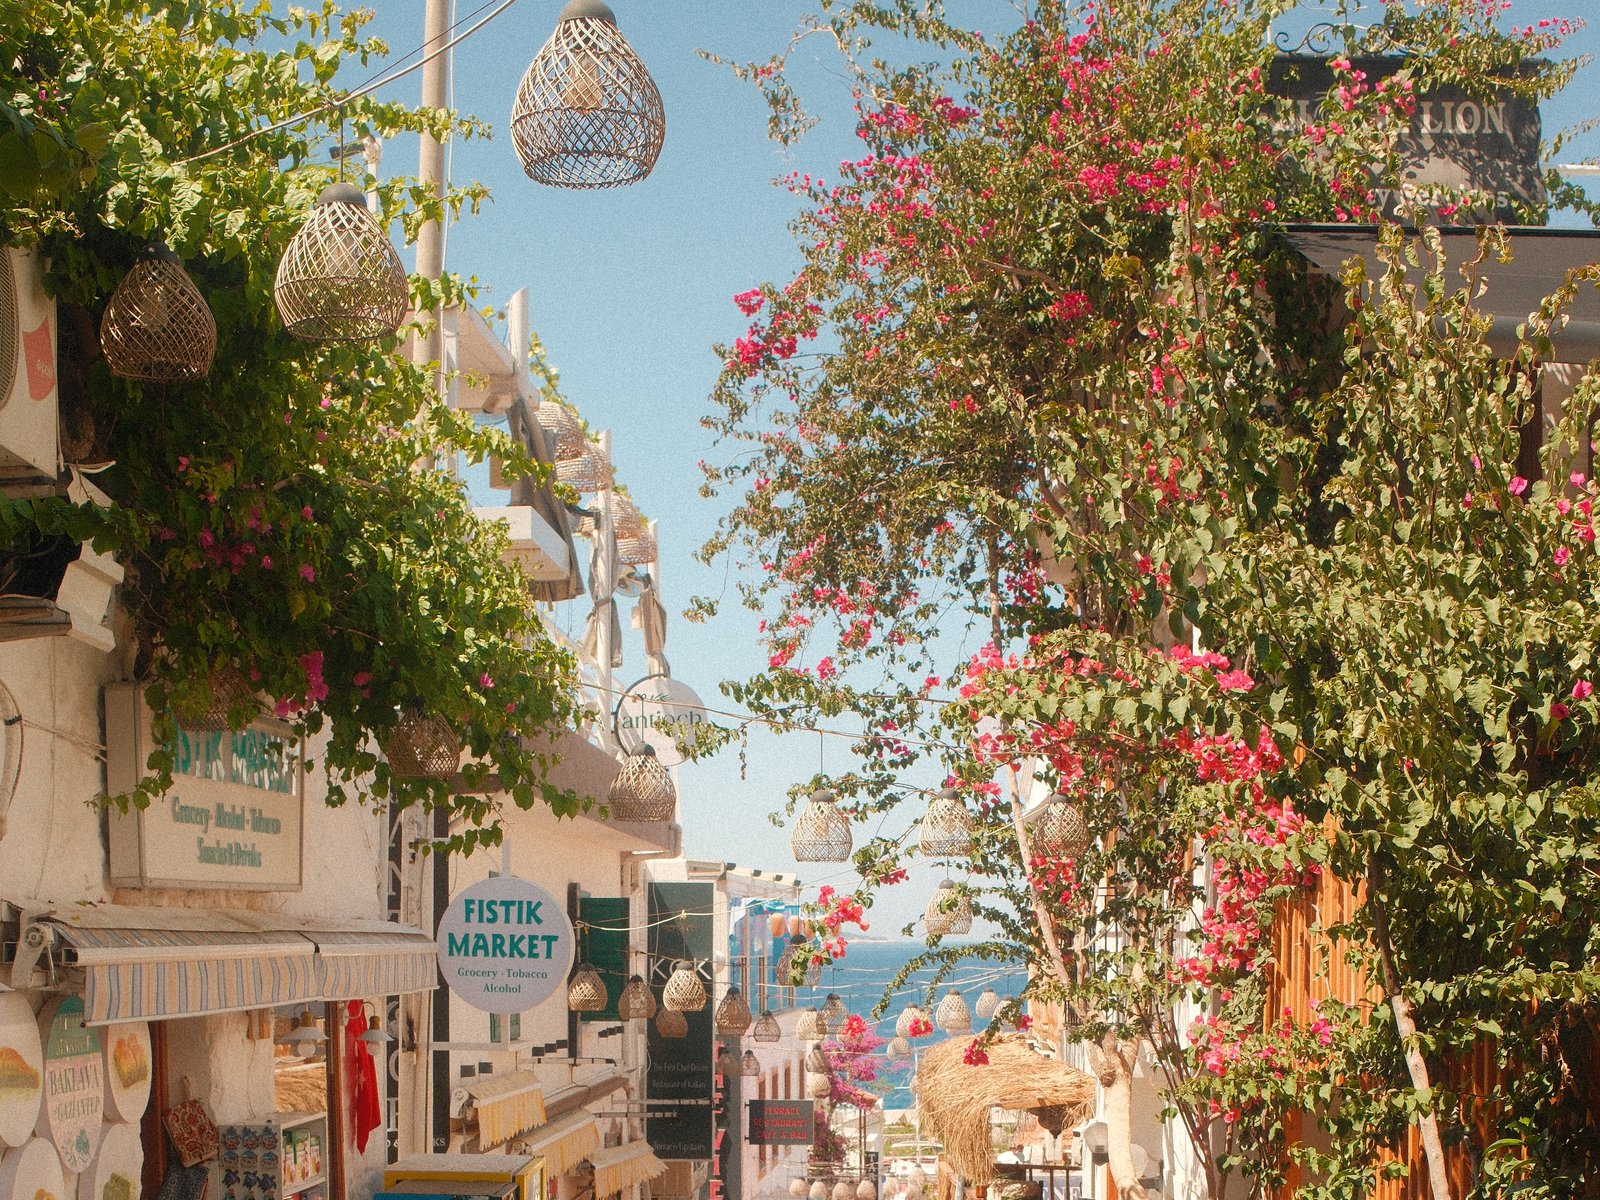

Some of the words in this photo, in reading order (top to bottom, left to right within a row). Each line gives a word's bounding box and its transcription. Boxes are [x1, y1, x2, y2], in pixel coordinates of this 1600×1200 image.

[1420, 101, 1505, 134] LION
[171, 796, 210, 834] Grocery
[464, 899, 543, 925] FISTIK
[447, 932, 559, 959] MARKET
[457, 967, 498, 980] Grocery
[506, 968, 548, 979] Tobacco
[650, 957, 712, 980] KK
[483, 983, 521, 993] Alcohol
[50, 1065, 100, 1096] BAKLAVA
